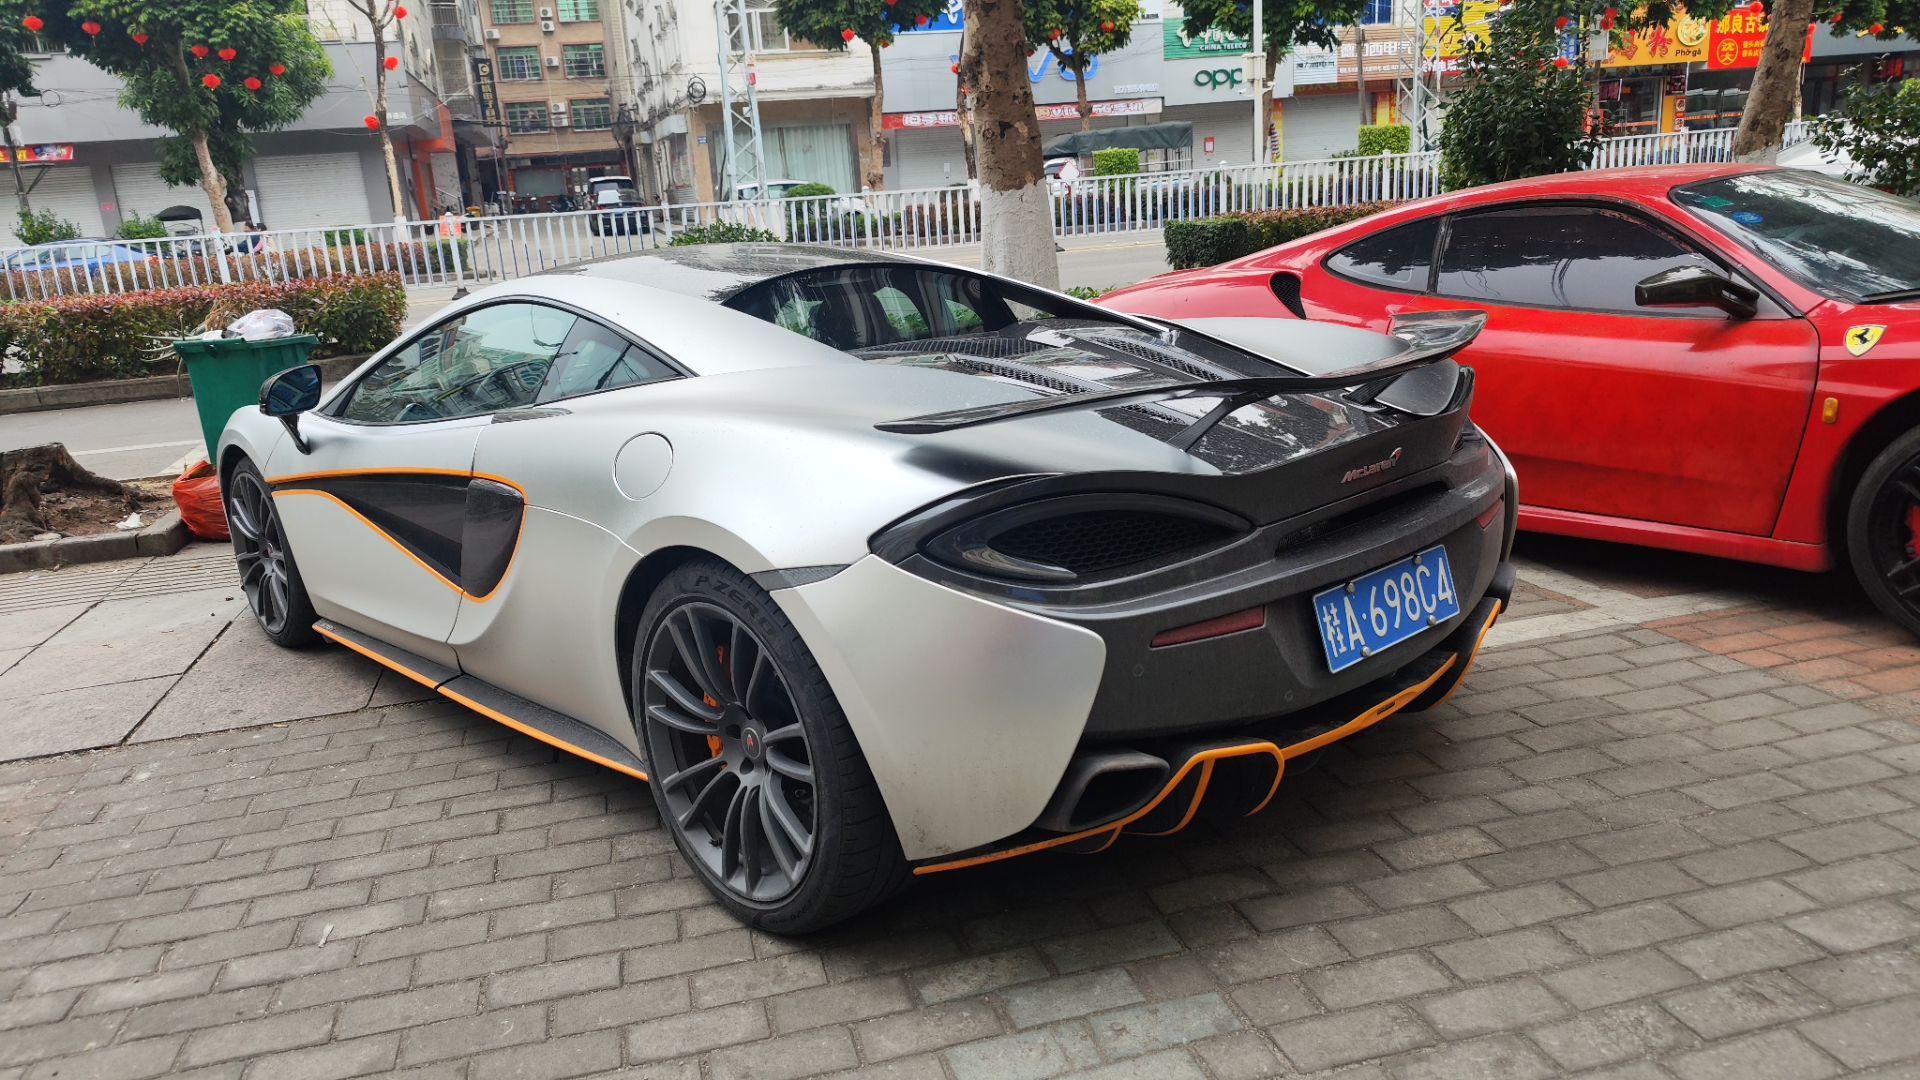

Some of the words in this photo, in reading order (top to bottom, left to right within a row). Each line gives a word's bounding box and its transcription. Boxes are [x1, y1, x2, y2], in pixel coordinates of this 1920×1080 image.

[1223, 42, 1249, 50] TELECO
[1194, 67, 1243, 90] opp
[1340, 457, 1398, 484] McLaren
[695, 574, 709, 587] P
[711, 579, 778, 637] ZERO
